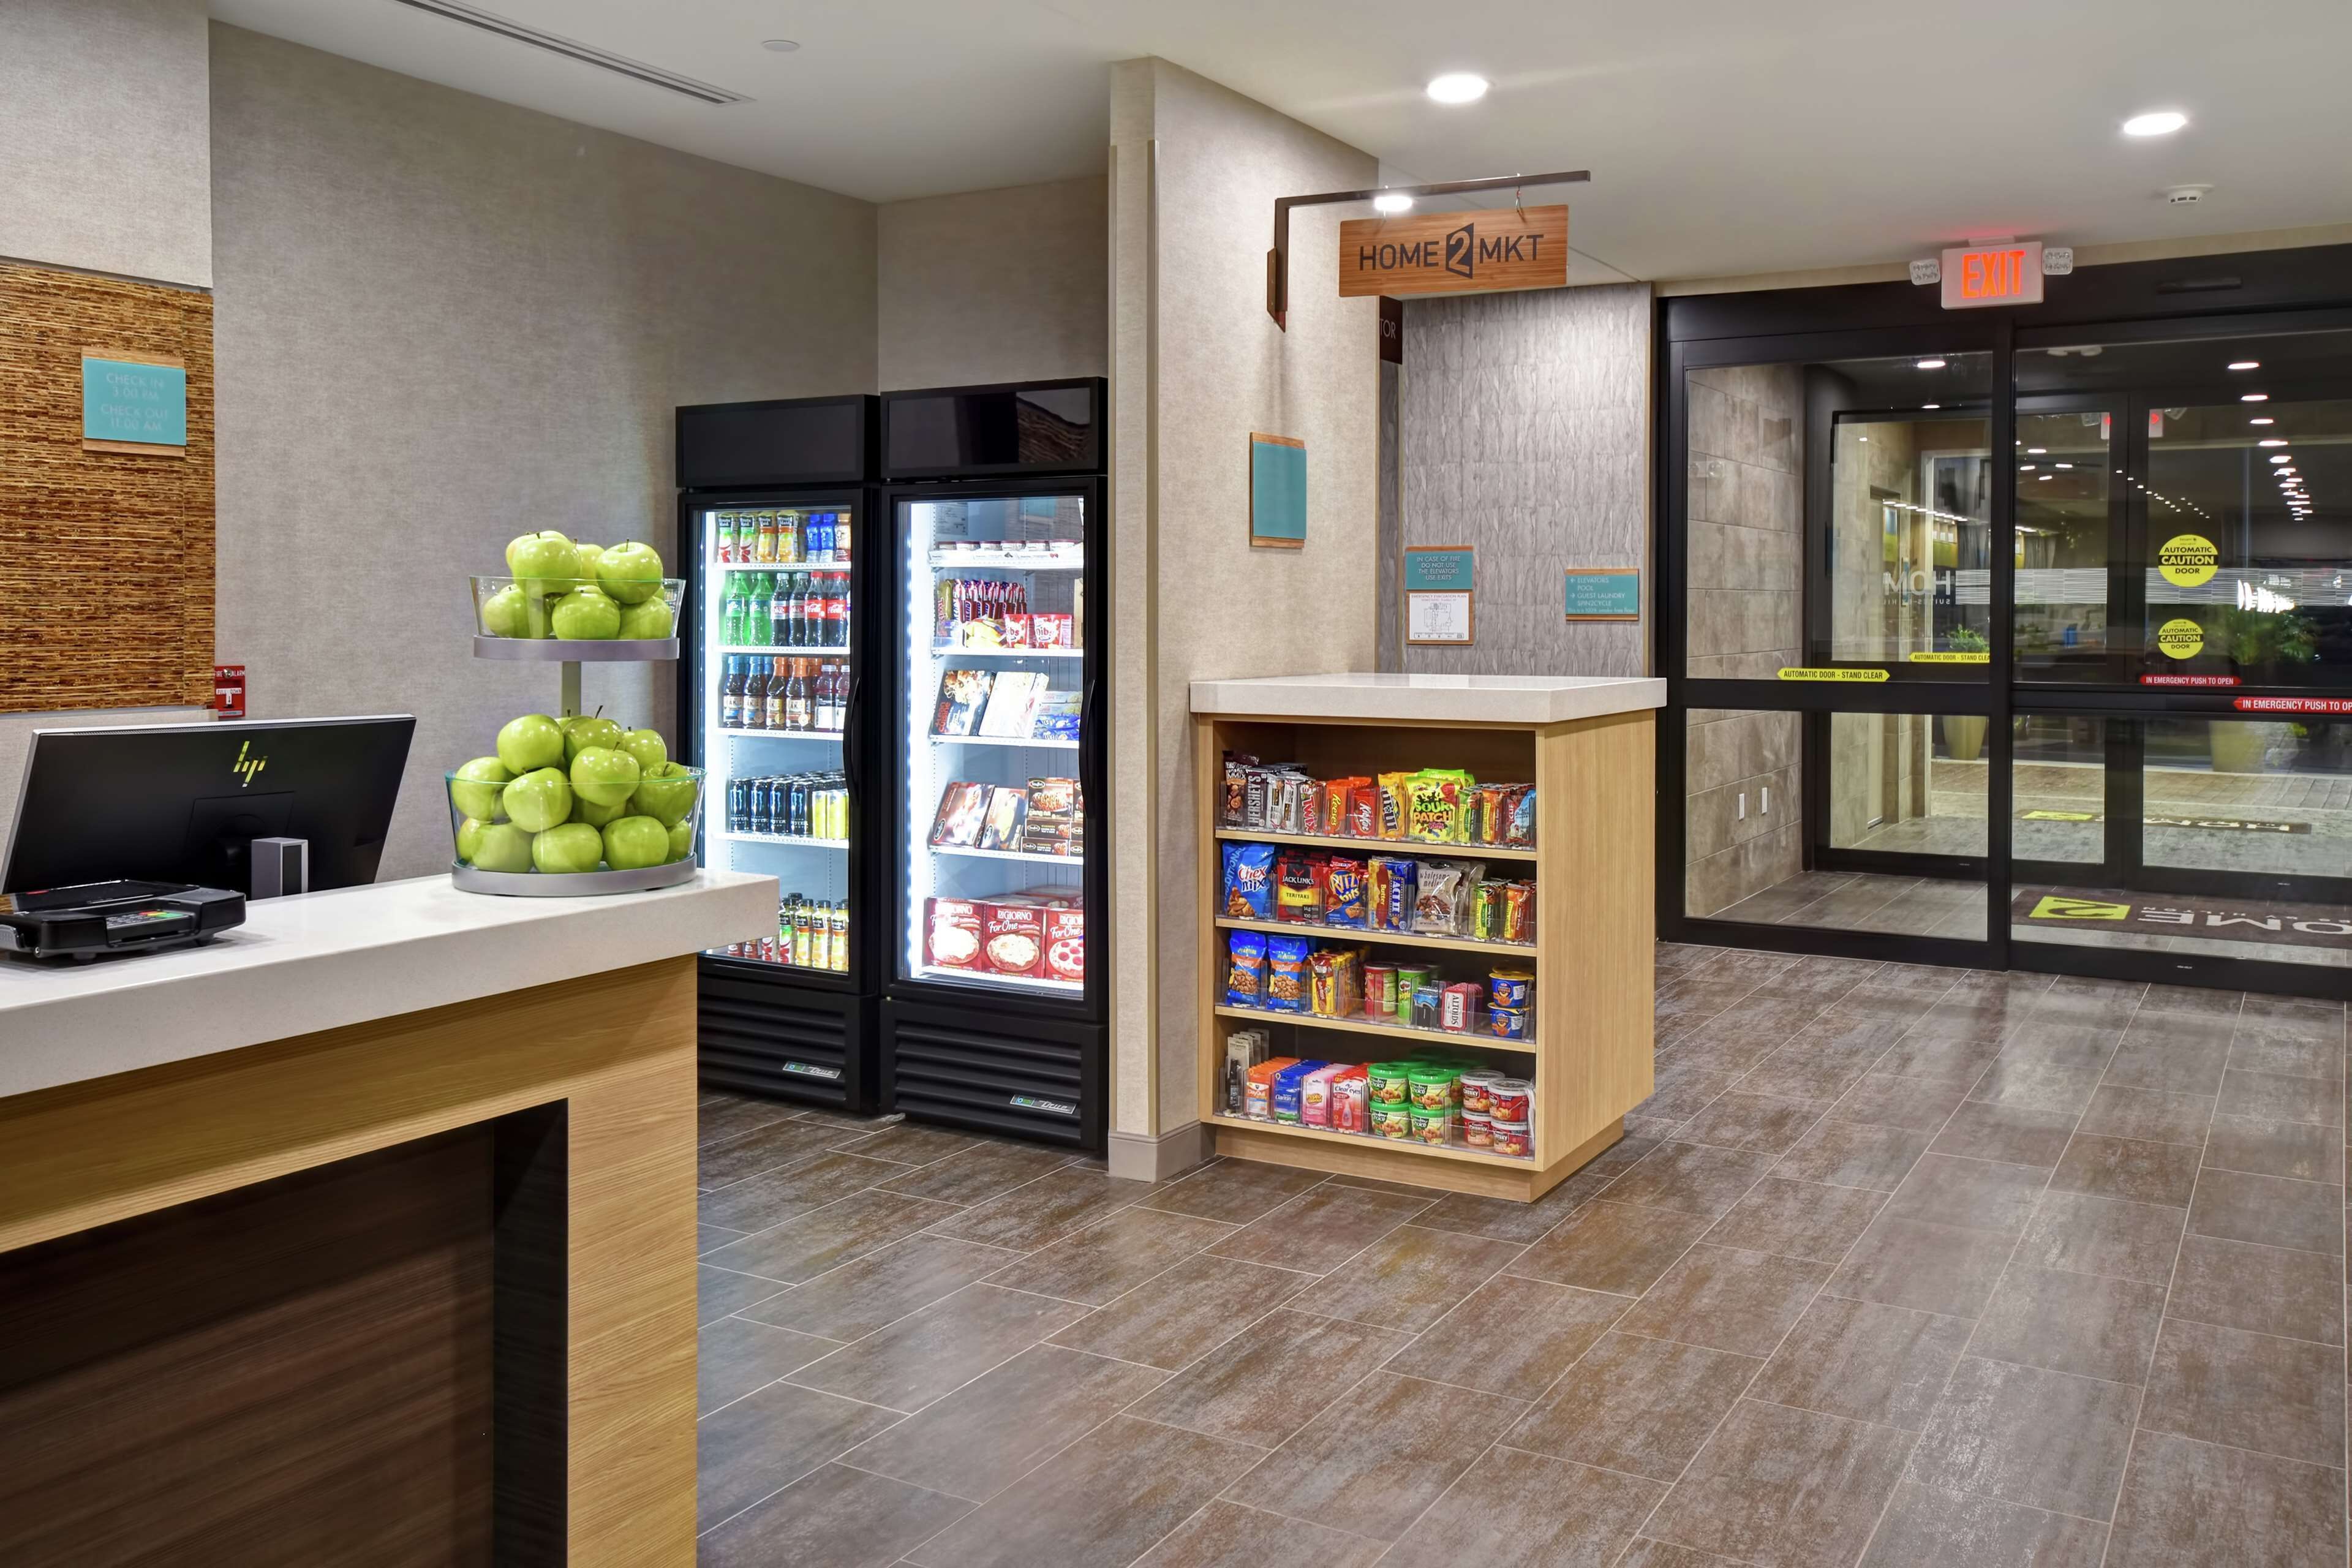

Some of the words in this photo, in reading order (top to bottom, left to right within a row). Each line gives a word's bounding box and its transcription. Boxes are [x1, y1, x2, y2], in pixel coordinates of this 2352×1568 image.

[1359, 241, 1439, 270] HOME
[1479, 234, 1544, 263] MKT
[1962, 251, 2026, 299] EXIT
[106, 372, 147, 387] CHECK
[150, 377, 164, 390] IN
[100, 403, 140, 417] CHECK
[145, 408, 167, 421] OUT
[143, 421, 162, 432] AM
[2162, 556, 2214, 565] CAUTION
[1783, 670, 1817, 679] AUTOMATIC
[2242, 699, 2251, 709] IN
[2253, 700, 2302, 710] EMERGENCY
[2305, 701, 2326, 710] PUSH
[2329, 701, 2340, 710] TO
[233, 740, 268, 788] hp
[1248, 775, 1262, 824] HERSHEY'S
[1414, 801, 1450, 812] SOUR
[1413, 811, 1452, 823] PATCH
[1238, 863, 1267, 881] Chex
[1282, 875, 1297, 884] JACK
[1331, 872, 1357, 894] RITZ
[1392, 880, 1401, 898] ACT
[998, 910, 1033, 921] DIGIORNO
[988, 920, 1002, 933] For
[1001, 919, 1018, 932] One
[1050, 925, 1065, 939] For
[1064, 925, 1081, 937] One
[1451, 995, 1460, 1025] ALTOIDS
[809, 1066, 835, 1076] True
[1039, 1099, 1071, 1111] True
